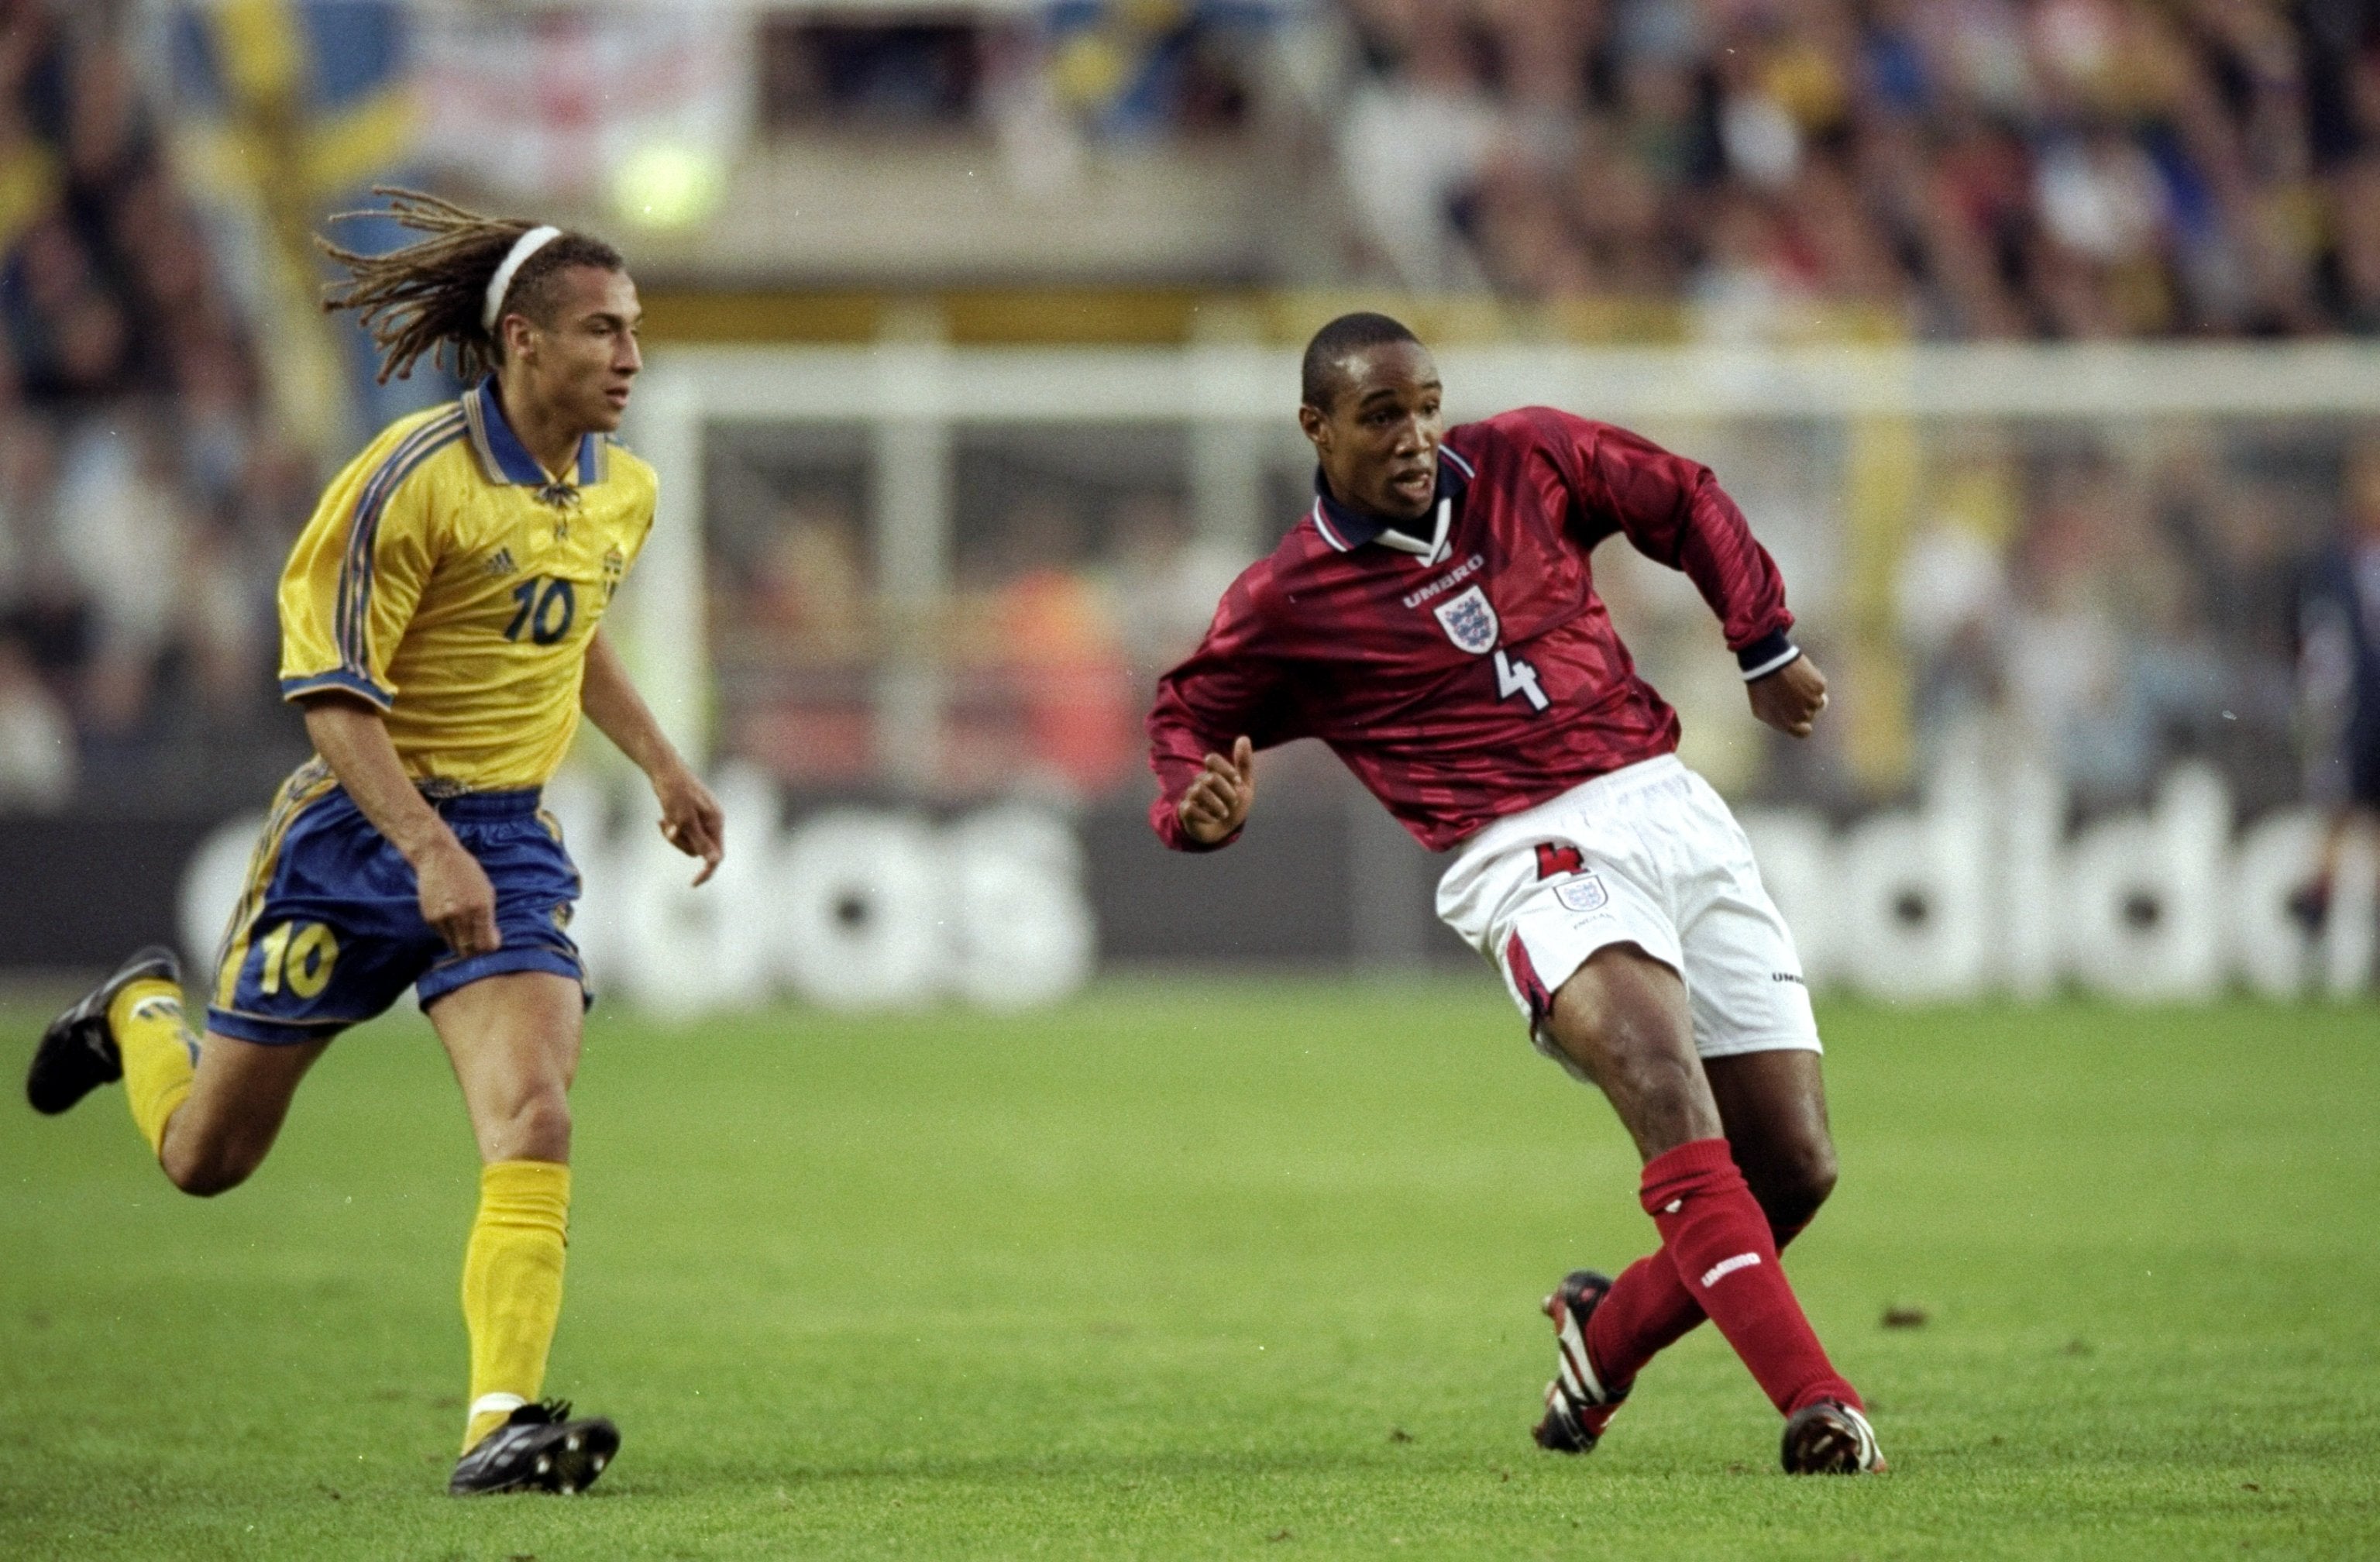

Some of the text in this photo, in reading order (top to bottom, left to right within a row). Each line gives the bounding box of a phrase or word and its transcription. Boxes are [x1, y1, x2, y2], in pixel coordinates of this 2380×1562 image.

[505, 575, 574, 645] 10
[1402, 553, 1484, 609] UMBRO
[1494, 649, 1549, 711] 4
[260, 920, 339, 999] 10
